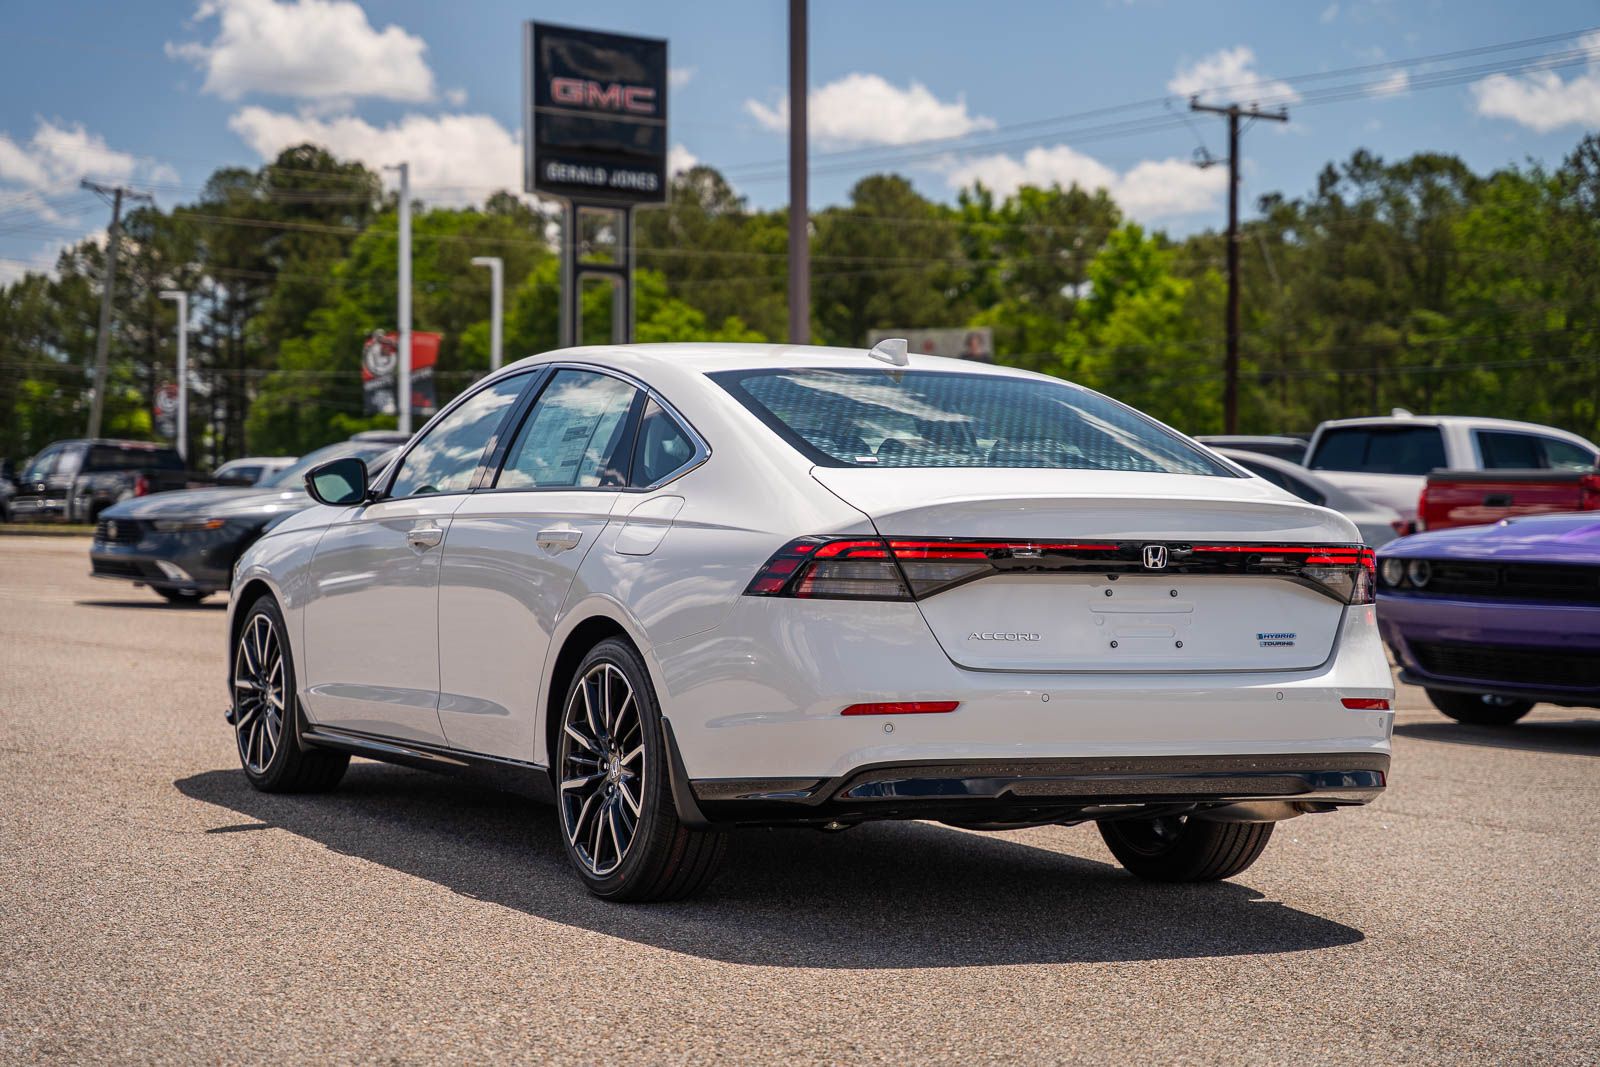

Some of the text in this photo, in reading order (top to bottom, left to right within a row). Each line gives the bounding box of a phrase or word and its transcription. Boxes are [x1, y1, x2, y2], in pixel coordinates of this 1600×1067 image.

[551, 77, 656, 113] GMC
[546, 161, 658, 191] GERALD JONES
[967, 632, 1041, 641] ACCORD
